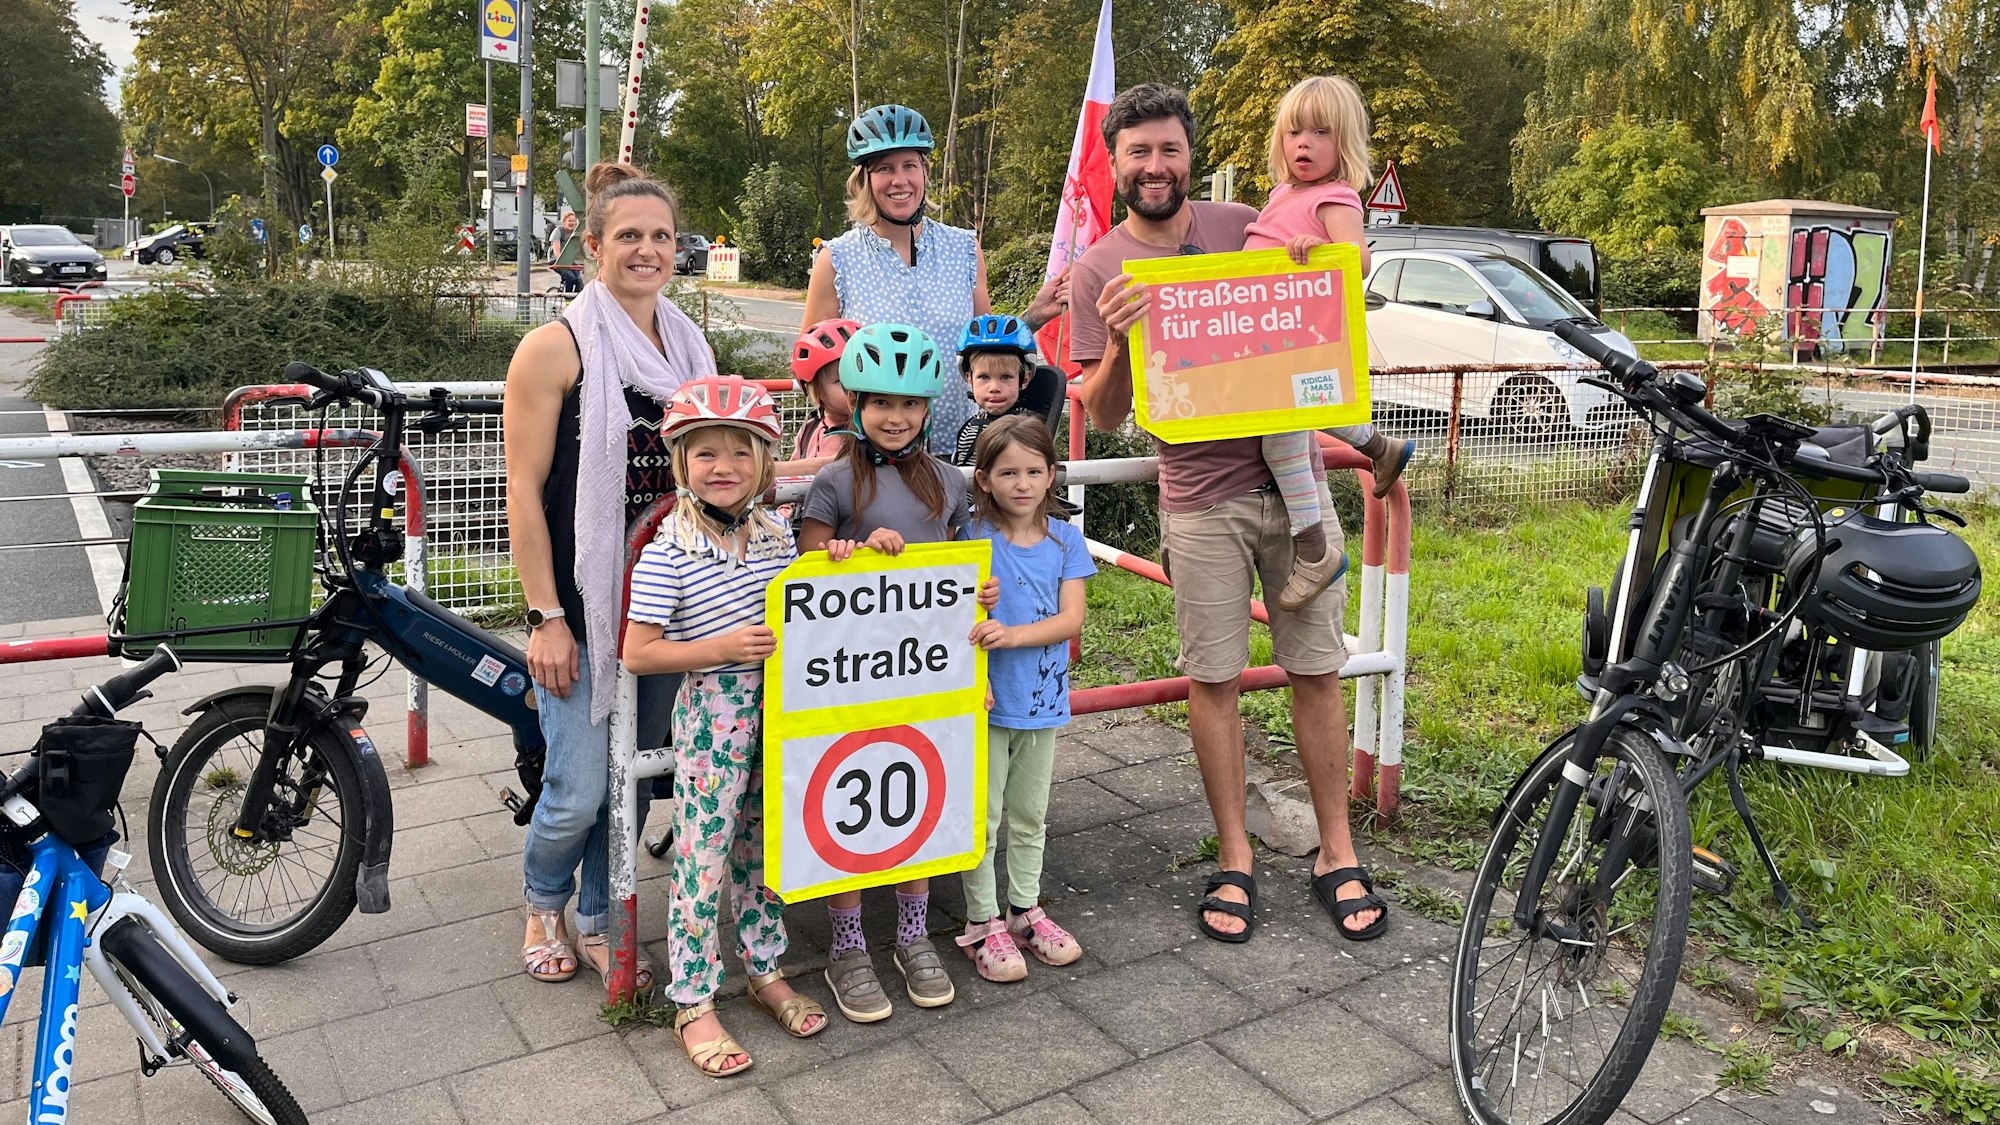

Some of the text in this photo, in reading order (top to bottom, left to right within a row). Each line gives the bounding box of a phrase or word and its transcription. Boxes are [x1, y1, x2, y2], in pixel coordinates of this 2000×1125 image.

[1158, 271, 1333, 311] Straßen sind
[1161, 304, 1303, 341] für alle da!
[1300, 375, 1334, 386] KIDICAL
[1310, 383, 1334, 392] MASS
[783, 574, 976, 624] Rochus-
[1648, 562, 1685, 653] GIANT
[422, 631, 446, 647] RIESE
[805, 636, 949, 688] straße
[835, 761, 916, 836] 30
